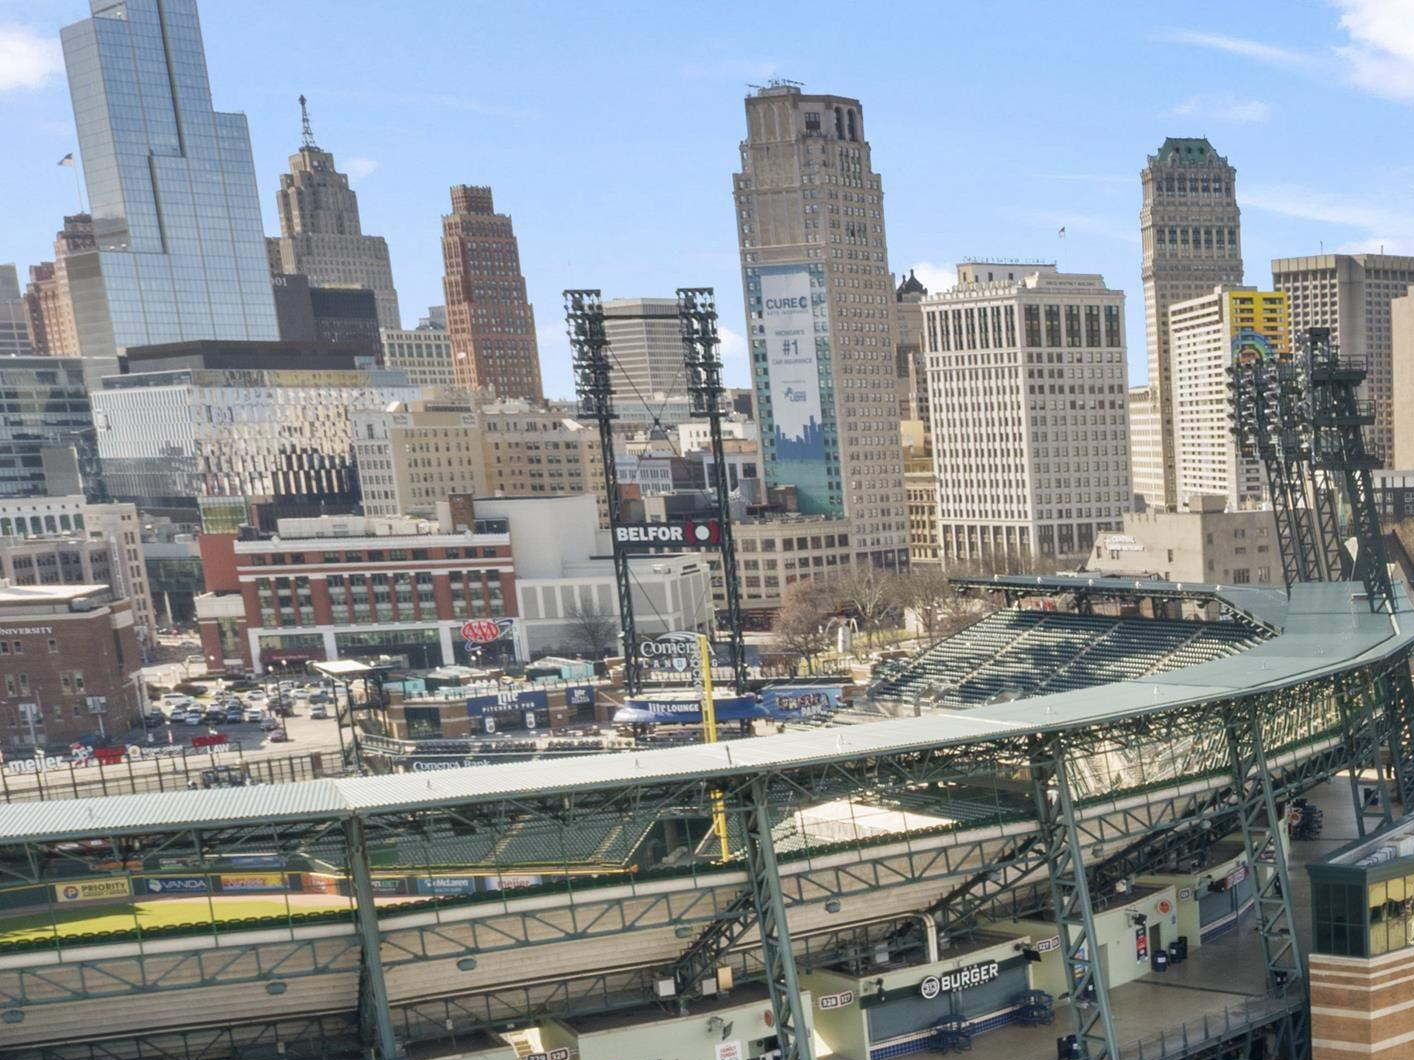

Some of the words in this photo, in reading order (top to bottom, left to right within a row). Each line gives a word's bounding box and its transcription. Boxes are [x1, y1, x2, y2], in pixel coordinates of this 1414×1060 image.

[766, 297, 798, 310] CURE
[783, 339, 799, 356] #1
[616, 526, 684, 542] BELFOR
[8, 753, 63, 774] meijer
[81, 880, 126, 892] PRIORITY
[162, 878, 207, 890] VANDA
[941, 963, 999, 991] BURGER
